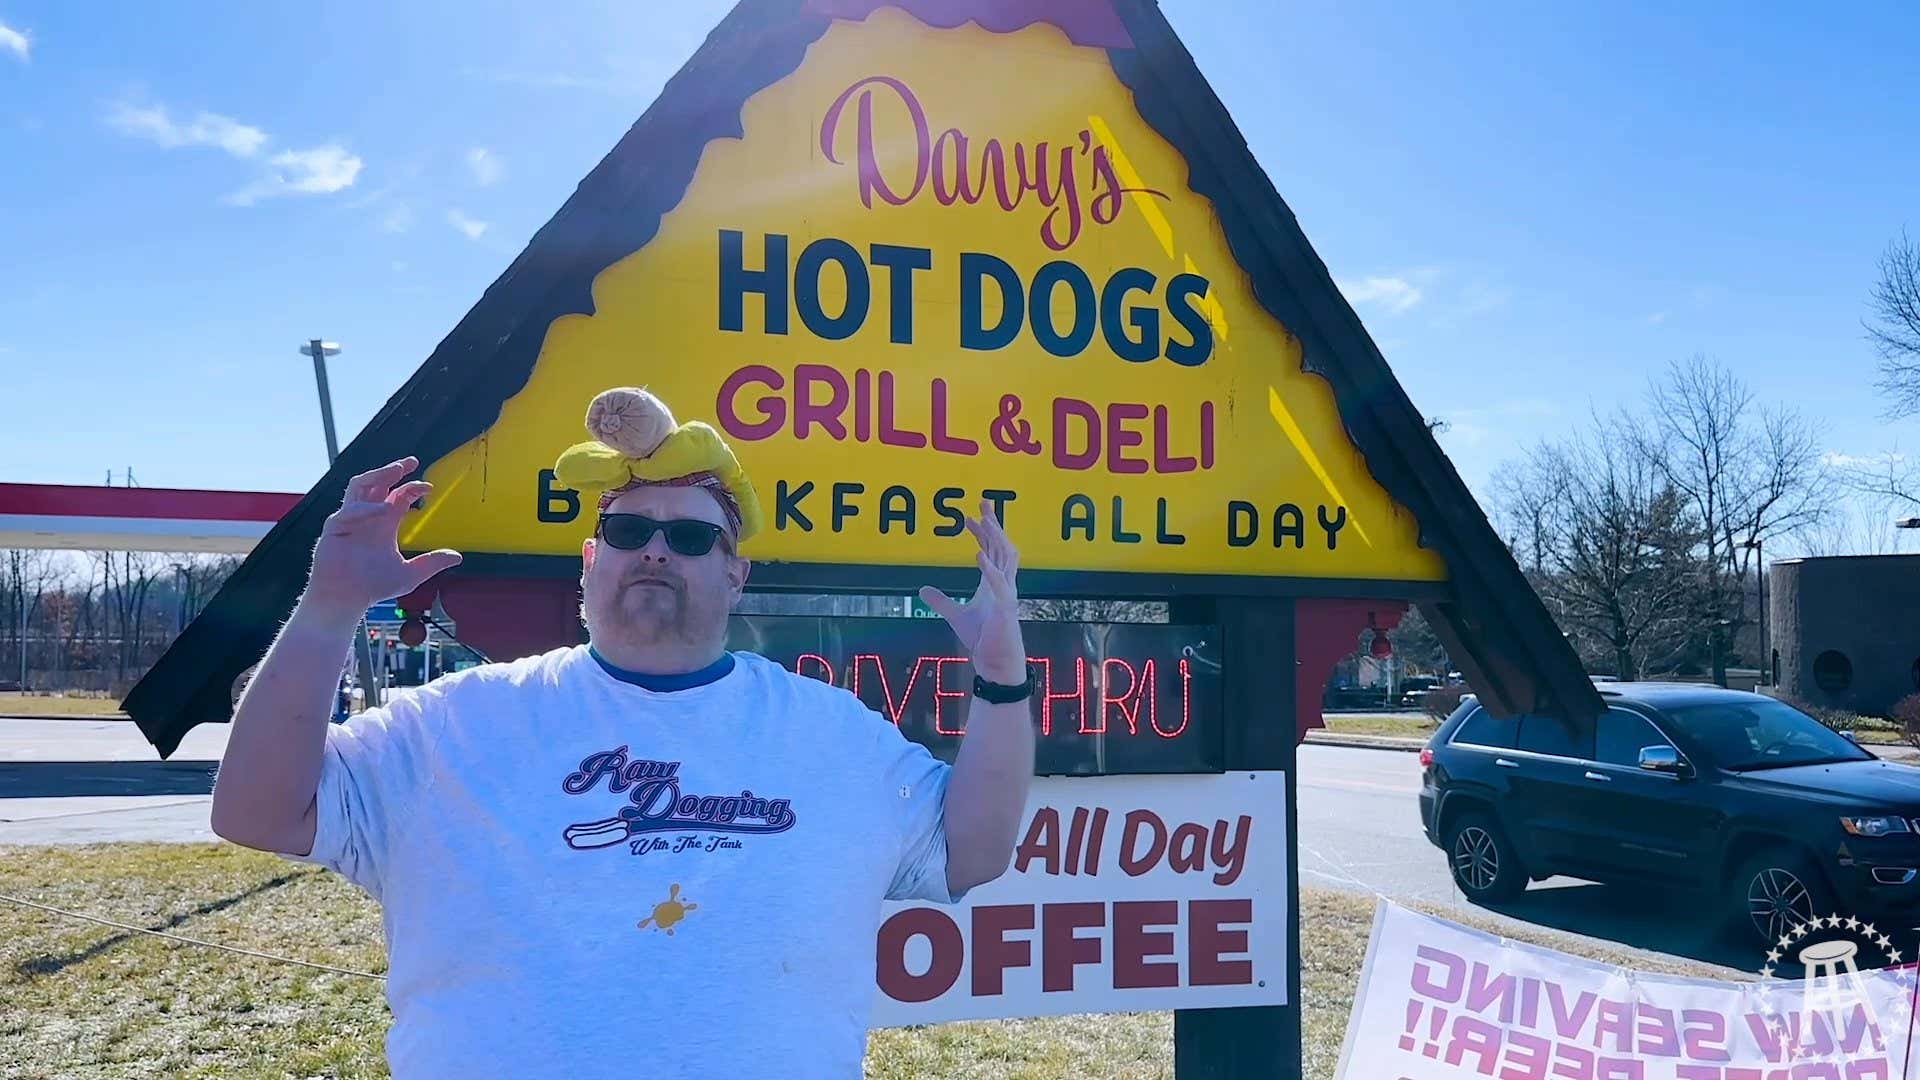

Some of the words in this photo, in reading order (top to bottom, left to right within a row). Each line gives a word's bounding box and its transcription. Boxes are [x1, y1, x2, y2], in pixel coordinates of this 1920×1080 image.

[820, 77, 1171, 251] Davy's
[718, 229, 932, 346] HOT
[960, 252, 1214, 367] DOGS
[716, 364, 979, 456] GRILL
[989, 393, 1042, 456] &
[1052, 397, 1214, 474] DELI
[537, 468, 1017, 538] BKFAST
[1061, 493, 1185, 545] ALL
[1228, 500, 1346, 550] DAY
[562, 745, 680, 795] Raw
[618, 777, 796, 828] Dogging
[629, 836, 669, 856] With
[672, 835, 702, 853] The
[704, 836, 743, 852] Tank
[1014, 806, 1109, 876] All
[1118, 809, 1252, 886] Day
[876, 899, 1253, 1003] OFFEE
